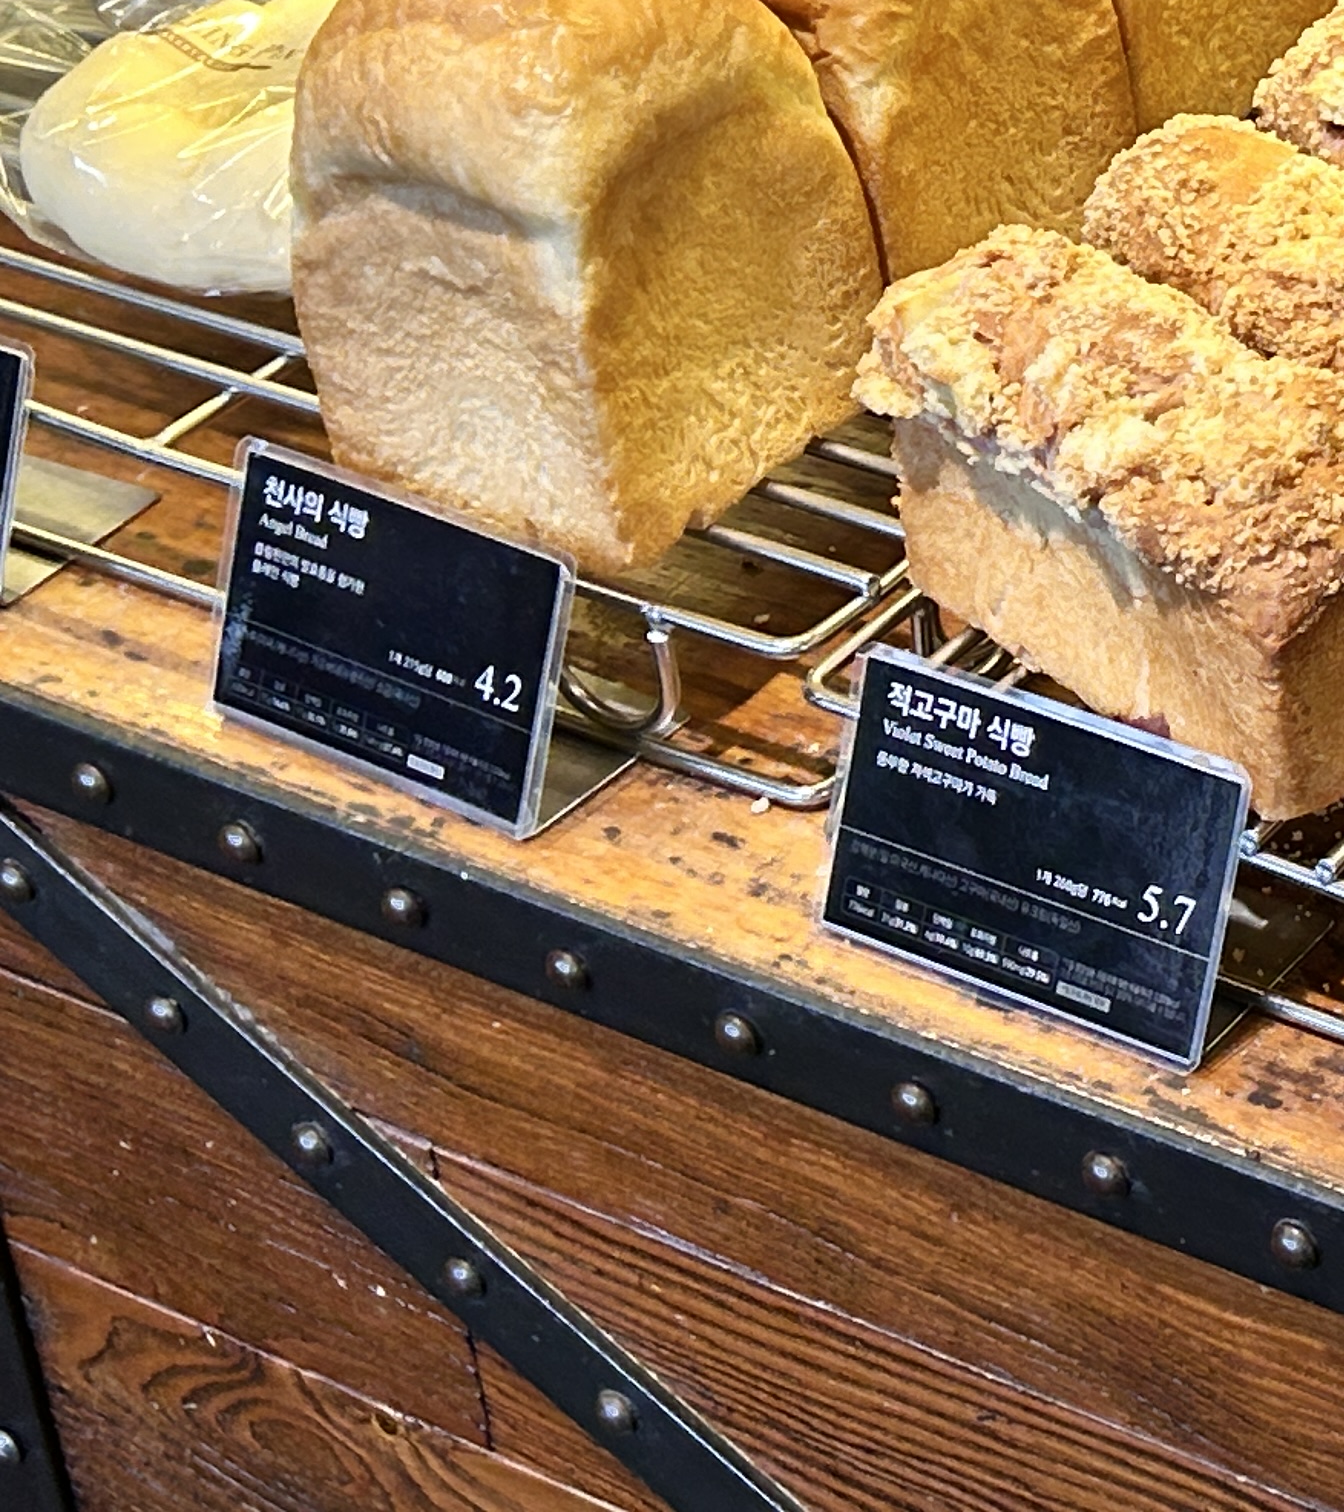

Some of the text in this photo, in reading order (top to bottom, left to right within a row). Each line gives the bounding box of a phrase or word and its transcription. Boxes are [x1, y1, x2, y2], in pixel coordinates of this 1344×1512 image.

[263, 476, 370, 539] 천사의 식빵
[474, 665, 522, 712] 4.2
[887, 682, 1036, 757] 적고구마 식빵
[883, 718, 1049, 790] Violet Sweet Potato Bread
[1137, 885, 1197, 934] 5.7
